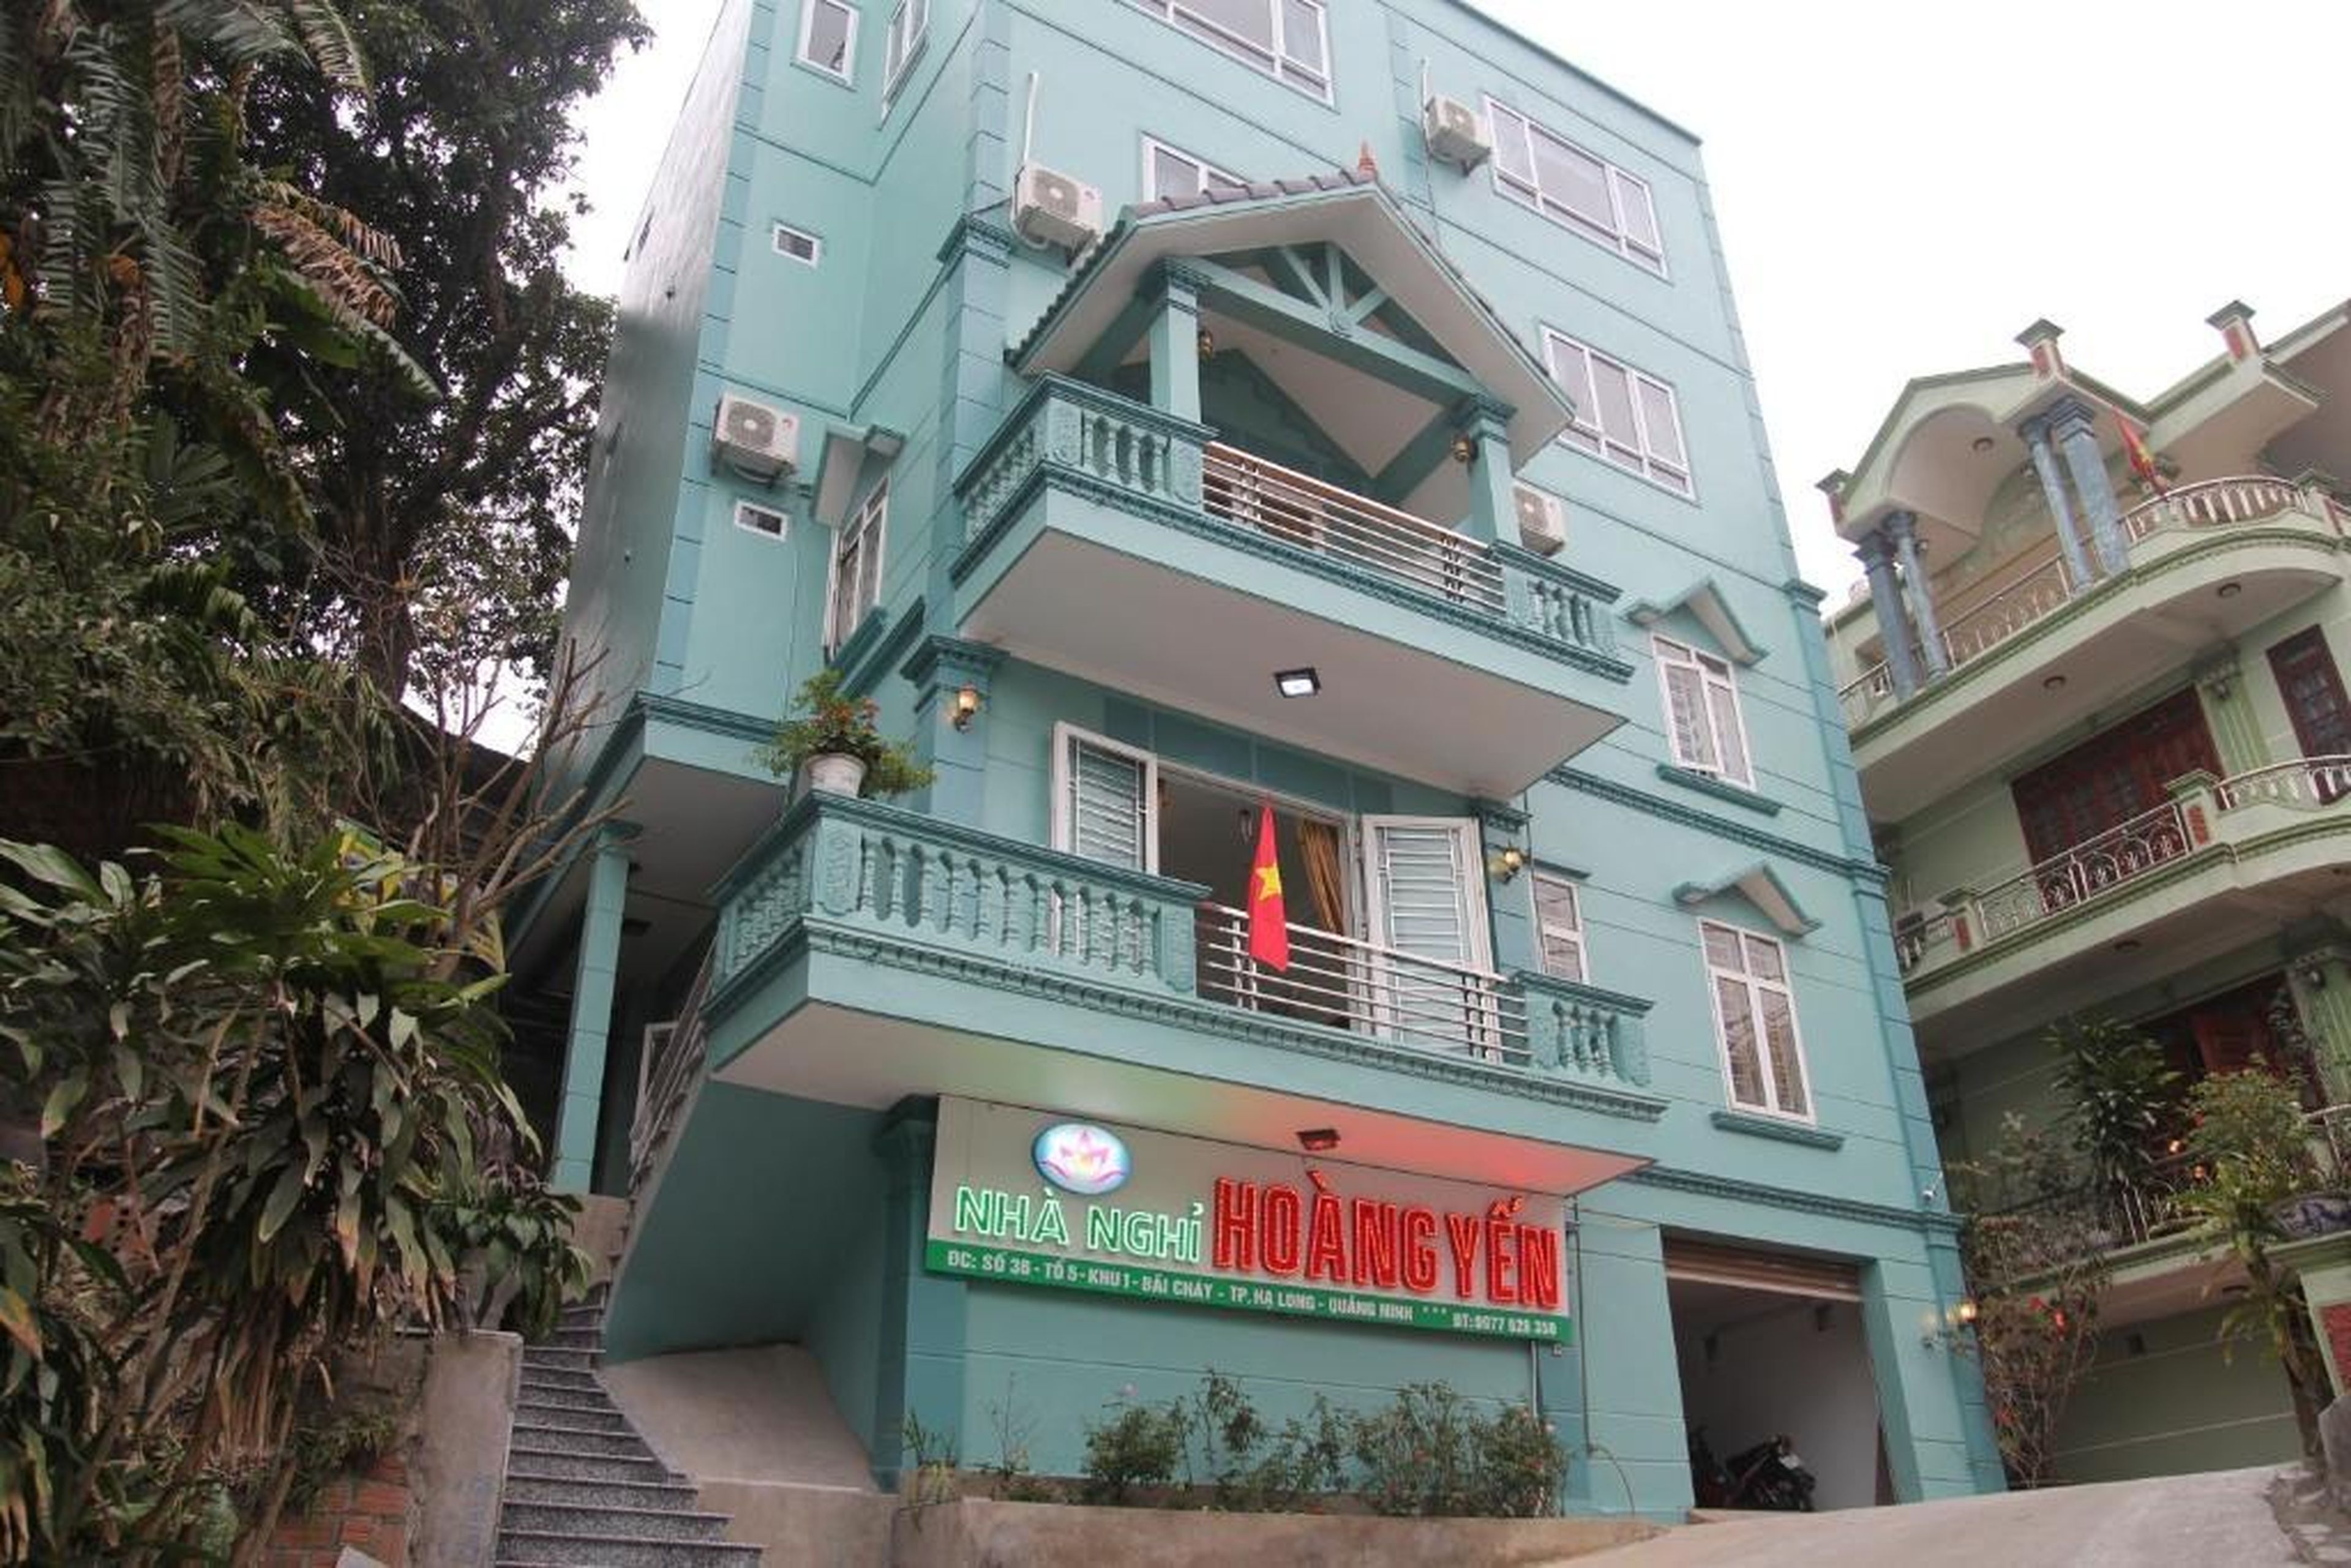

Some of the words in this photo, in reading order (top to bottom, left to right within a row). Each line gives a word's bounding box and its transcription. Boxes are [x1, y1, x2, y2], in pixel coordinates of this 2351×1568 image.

[955, 1187, 1069, 1247] NHÀ
[1087, 1202, 1205, 1264] NGHỈ
[1213, 1169, 1439, 1292] HOÀNG
[1445, 1196, 1559, 1310] YẾN
[1278, 1291, 1315, 1310] LONG
